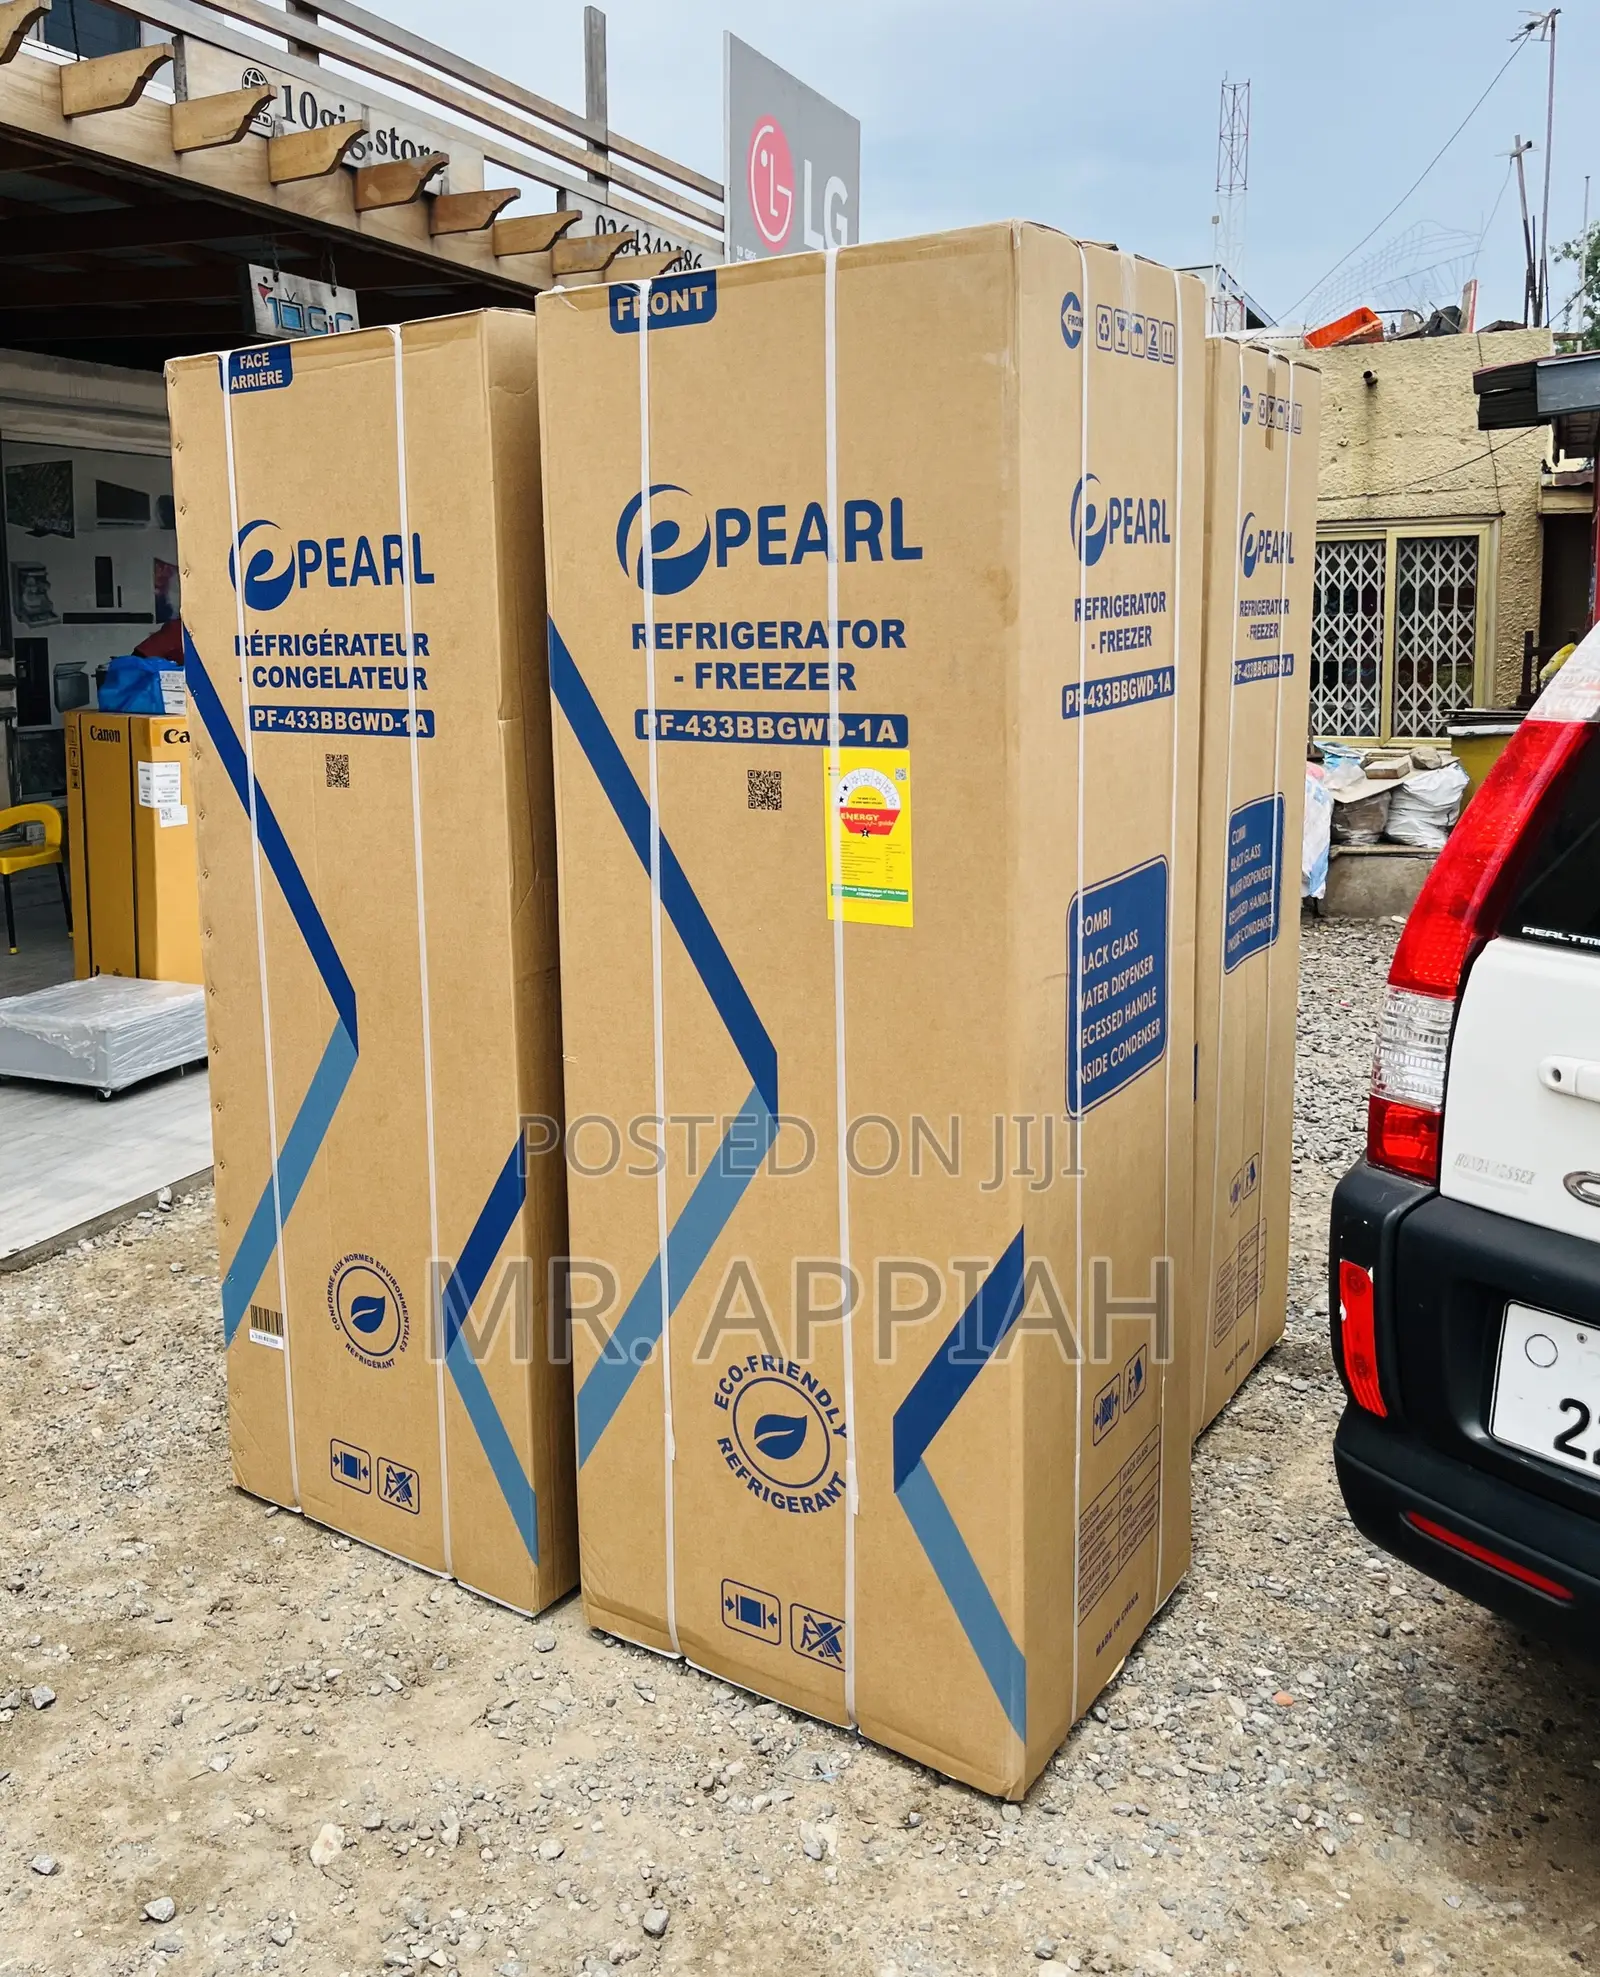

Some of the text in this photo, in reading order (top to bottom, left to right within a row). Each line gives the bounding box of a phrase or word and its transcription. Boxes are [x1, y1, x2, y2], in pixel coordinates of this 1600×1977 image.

[804, 158, 849, 251] LG
[616, 285, 708, 321] FRONT
[239, 352, 270, 370] FACE
[231, 369, 283, 390] ARRIÈRE
[715, 496, 923, 568] PEARL
[1108, 497, 1171, 545] PEARL
[297, 532, 435, 589] PEARL
[1257, 529, 1294, 564] PEARL
[1074, 591, 1167, 623] REFRIGERATOR
[1240, 598, 1290, 618] REFRIGERATOR
[234, 628, 430, 657] RÉFRIGÉRATEUR
[631, 619, 907, 651] REFRIGERATOR
[1099, 625, 1153, 654] FREEZER
[1250, 622, 1279, 641] FREEZER
[252, 666, 429, 691] CONGELATEUR
[694, 662, 857, 691] FREEZER
[1065, 671, 1172, 714] PF-433BBGWD-1A
[90, 725, 121, 743] Canon
[253, 709, 429, 734] PF-433BBGWD-1A
[641, 713, 899, 743] PF-433BBGWD-1A
[840, 812, 880, 822] ENERGY
[1082, 928, 1139, 975] LACK GLASS
[1111, 954, 1154, 996] DISPENSER
[1081, 986, 1157, 1049] ECESSED HANDLE
[1080, 1018, 1160, 1085] NSIDE CONDENSER
[327, 1253, 410, 1353] CONFORME AUX NORMES ENVIRONMENTALES
[714, 1354, 847, 1441] ECO-FRIENDLY
[1553, 1397, 1600, 1466] 2
[717, 1437, 847, 1513] REFRIGERANT
